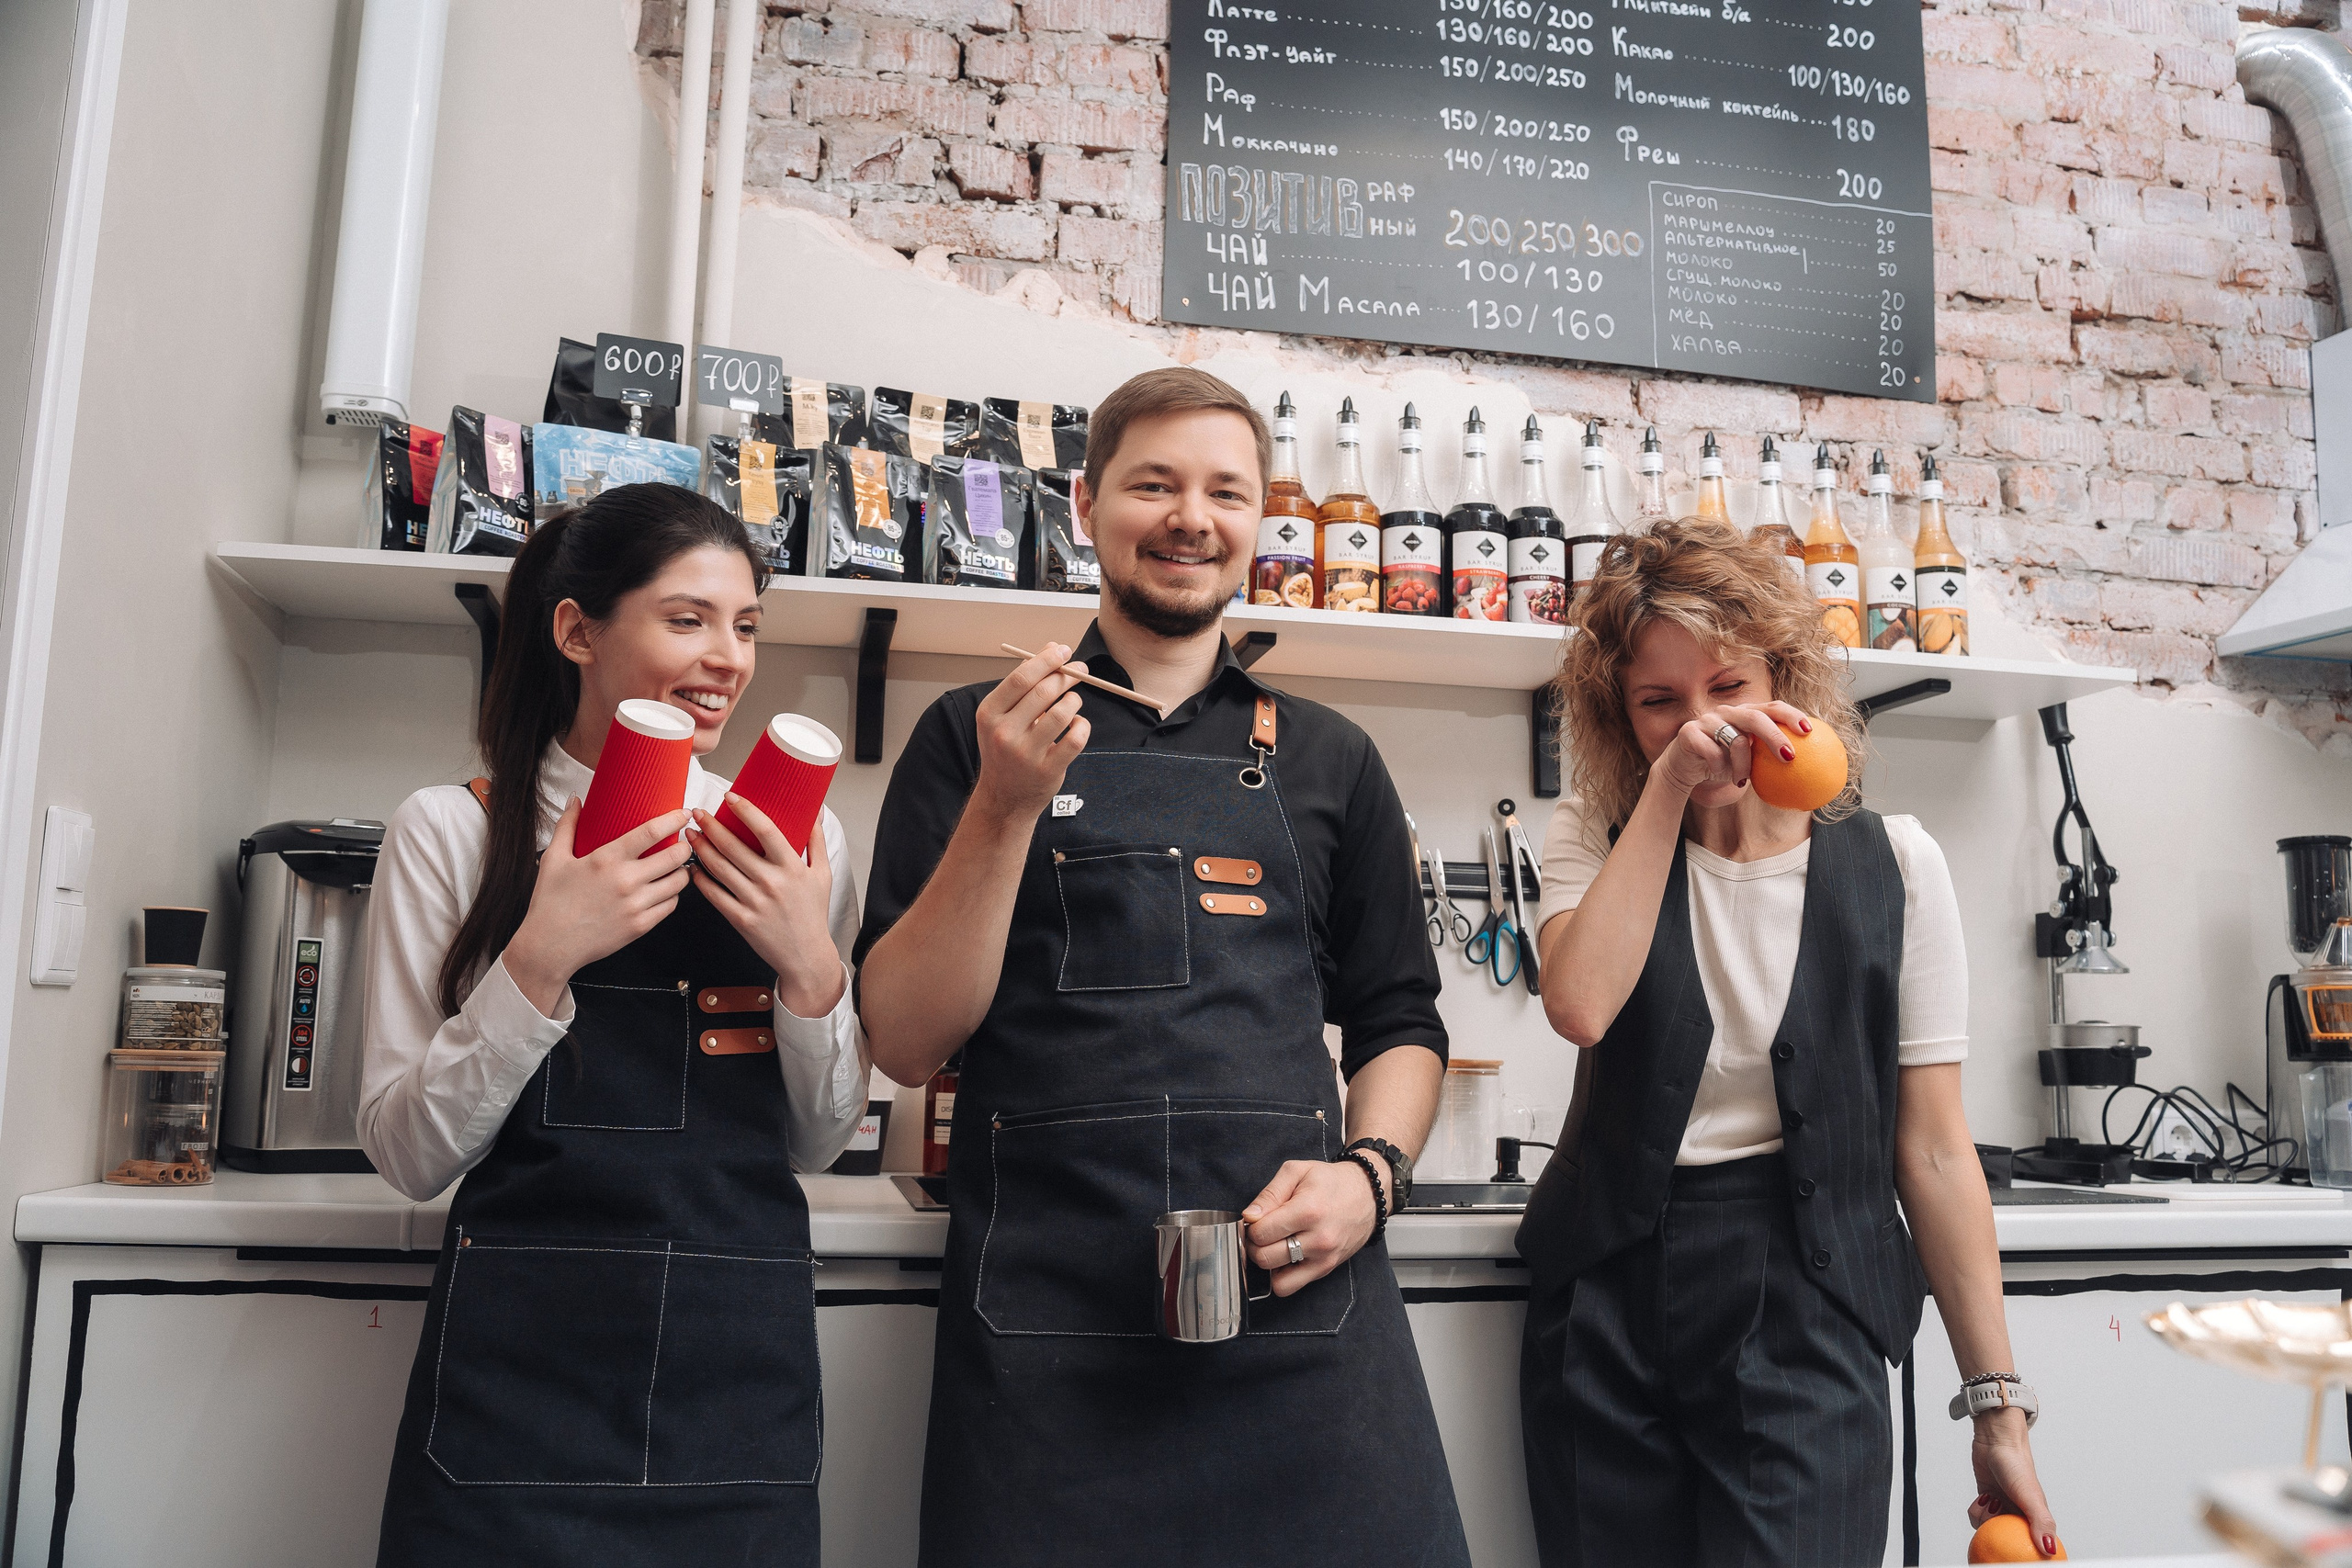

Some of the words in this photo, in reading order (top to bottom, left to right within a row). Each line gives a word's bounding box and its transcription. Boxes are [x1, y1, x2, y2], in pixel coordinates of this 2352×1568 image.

[1436, 17, 1594, 55] 130/160/200
[1827, 24, 1875, 50] 200
[1440, 55, 1587, 88] 150/200/250
[1611, 27, 1674, 61] Какао
[1788, 65, 1911, 105] 100/130/160
[1205, 73, 1257, 112] Раф
[1440, 107, 1590, 143] 150/200/250
[1615, 73, 1711, 110] Молочный
[1723, 99, 1799, 122] коктейль
[1831, 115, 1875, 142] 180
[1203, 112, 1339, 157] Моккачино
[1444, 148, 1590, 180] 140/170/220
[1616, 125, 1680, 165] Фреш
[1837, 169, 1883, 200] 200
[1179, 163, 1364, 240] ПОЗИТИВ
[1367, 182, 1416, 204] РАФ
[1663, 191, 1718, 211] СИРОП
[1876, 218, 1895, 235] 20
[1370, 217, 1417, 238] НЫЙ
[1666, 251, 1734, 270] МОЛОКО
[1877, 238, 1896, 254] 25
[1206, 233, 1269, 266] ЧАЙ
[1456, 258, 1603, 294] 100/130
[1878, 262, 1897, 276] 50
[1207, 271, 1277, 312] ЧАЙ
[1466, 299, 1615, 341] 130/160
[1668, 285, 1737, 306] МОЛОКО
[1880, 311, 1902, 332] 20
[1720, 276, 1782, 291] МОЛОКО
[1881, 289, 1905, 311] 20
[1670, 333, 1743, 355] ХАЛВА
[1880, 361, 1906, 387] 20
[1879, 334, 1904, 356] 20
[851, 540, 905, 564] НЕФТЬ
[856, 558, 875, 566] COFFEE
[960, 550, 1015, 572] НЕФТЬ
[1066, 559, 1101, 577] НЕФ
[1056, 800, 1072, 811] Cf
[300, 947, 318, 957] eco
[368, 1304, 382, 1328] 1
[2109, 1314, 2120, 1342] 4
